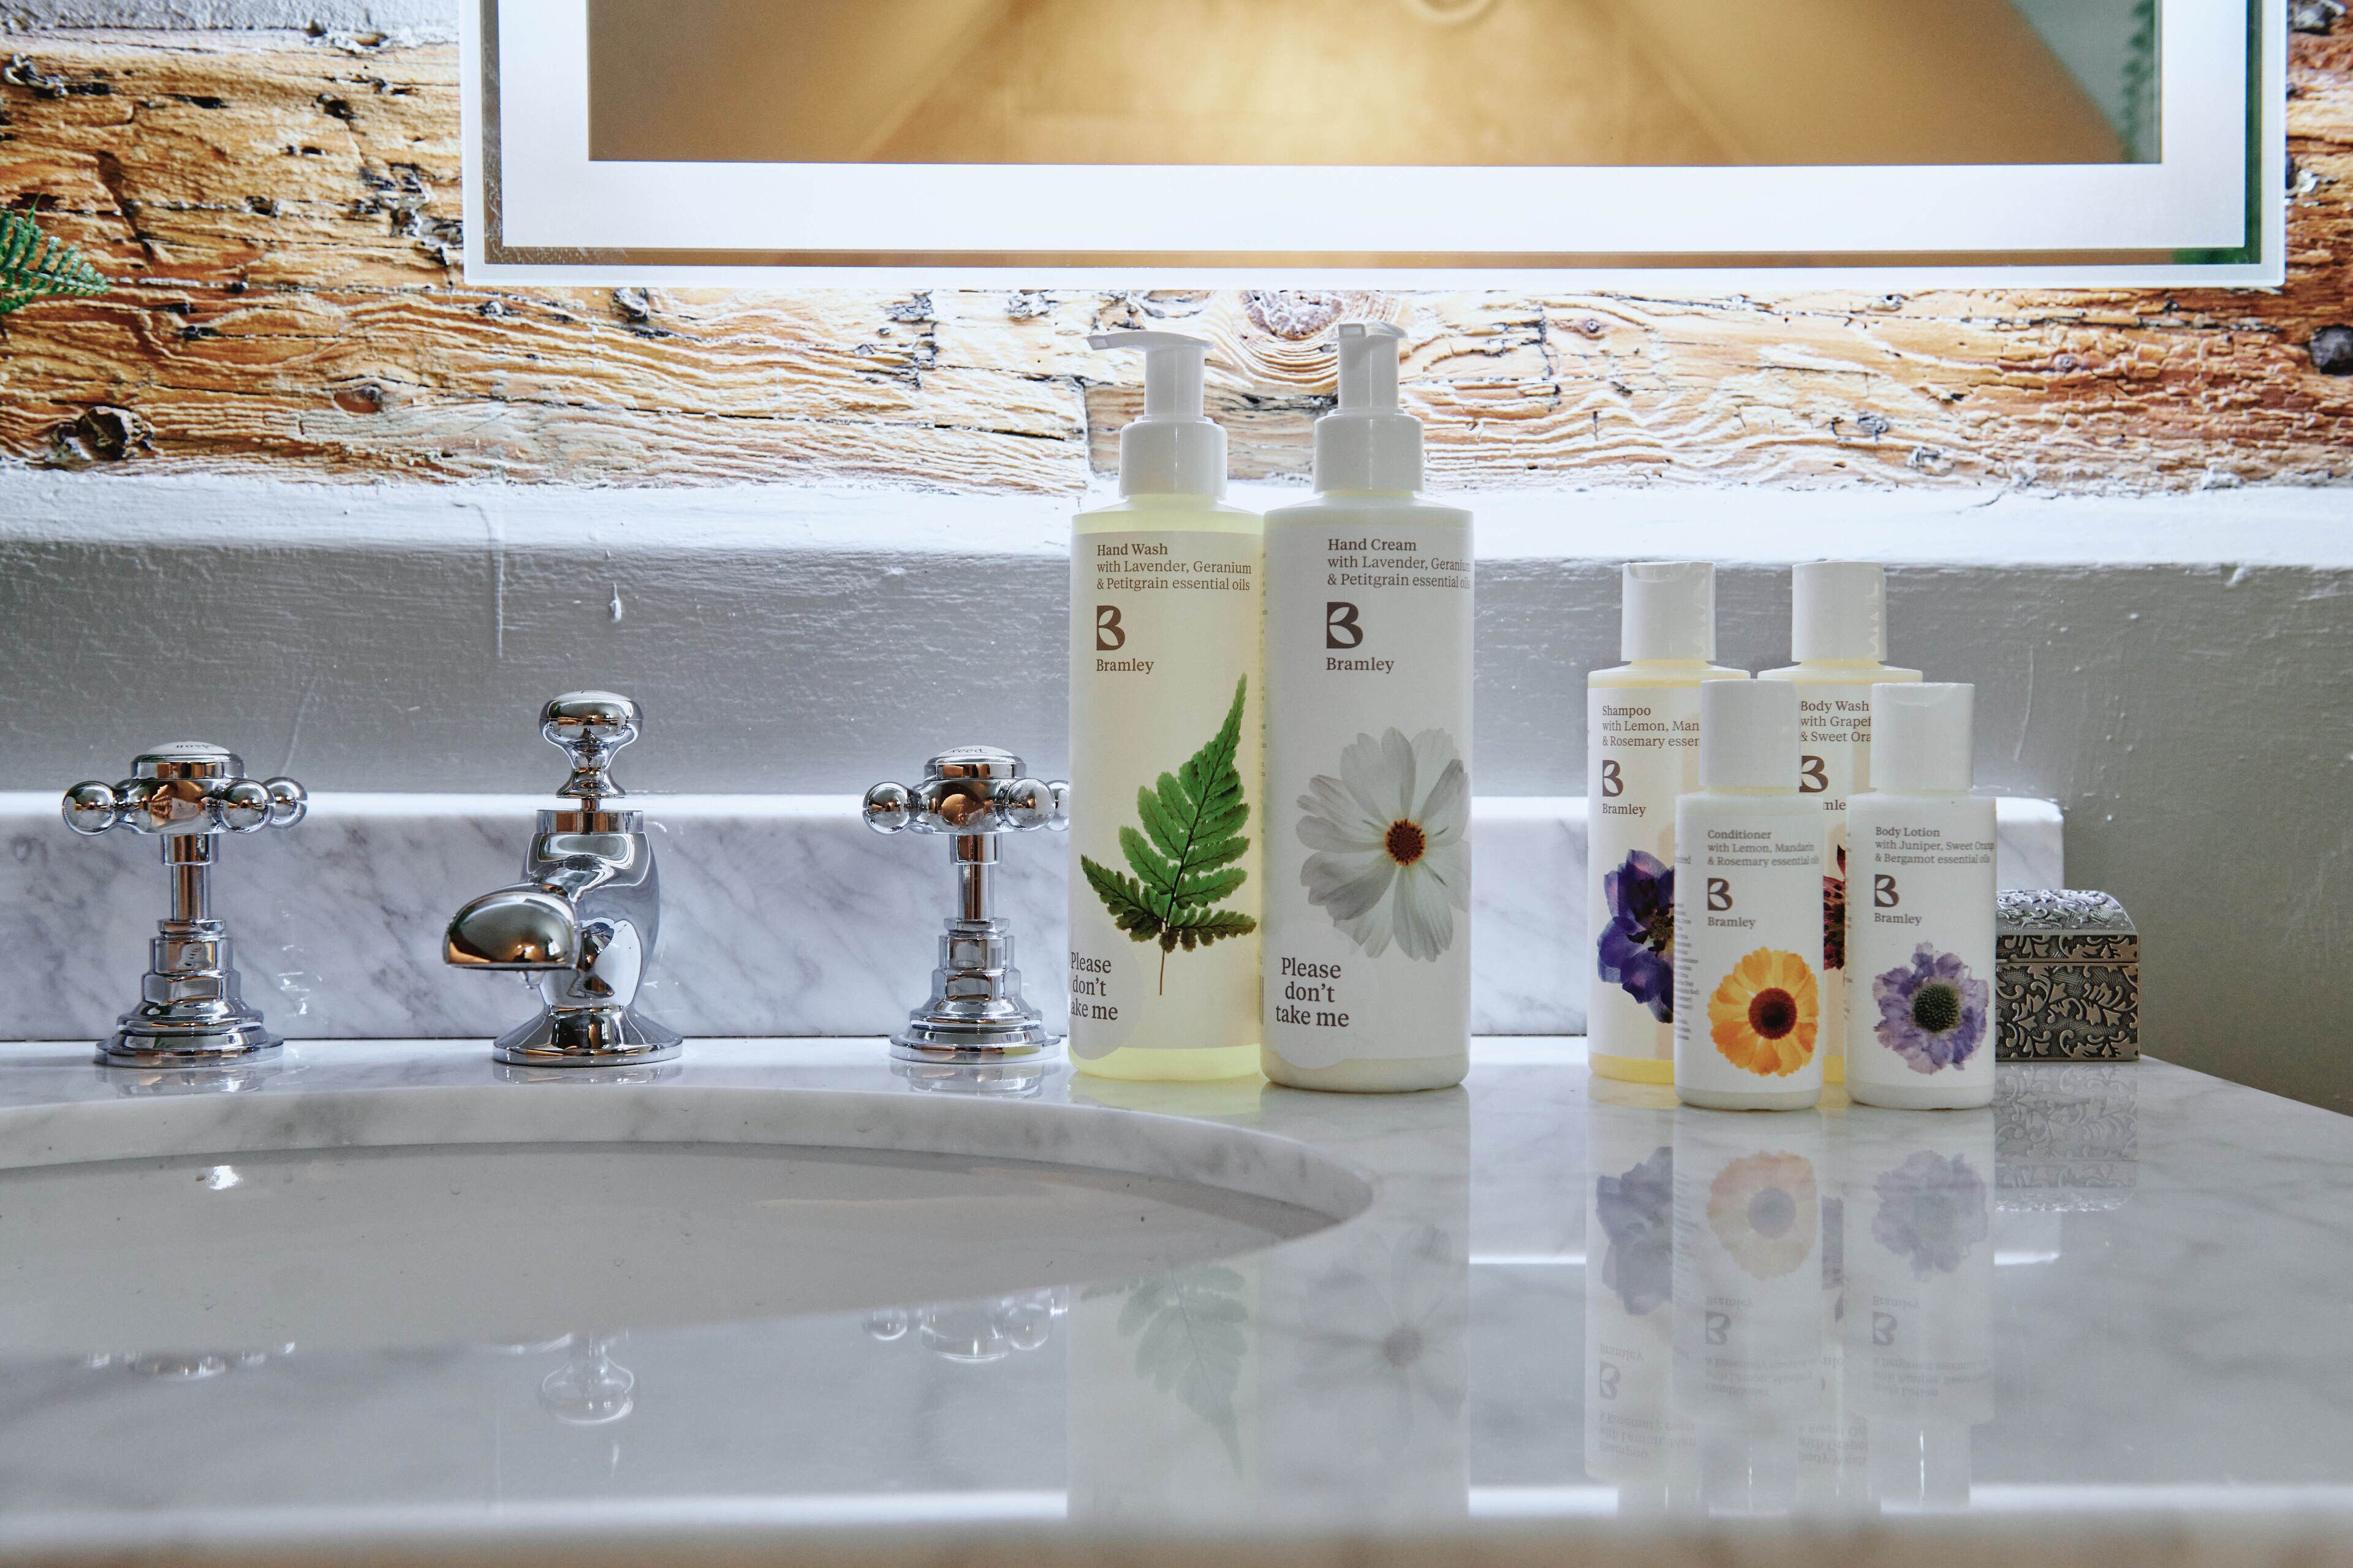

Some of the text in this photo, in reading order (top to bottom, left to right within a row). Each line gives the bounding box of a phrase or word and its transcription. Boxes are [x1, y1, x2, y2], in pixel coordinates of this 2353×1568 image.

[1097, 543, 1168, 556] Hand Wash
[1328, 539, 1417, 551] Hand Cream
[1097, 560, 1251, 574] with Lavender, Geranium
[1328, 556, 1358, 568] with
[1363, 556, 1428, 570] Lavender,
[1097, 577, 1250, 591] & Petitgrain essential oils
[1328, 575, 1337, 585] &
[1342, 574, 1409, 588] Petitgrain
[1413, 576, 1458, 588] essential
[1097, 605, 1126, 651] B
[1327, 602, 1363, 649] B
[1096, 658, 1154, 674] Bramley
[1327, 657, 1395, 673] Bramley
[1602, 705, 1651, 718] Shampoo
[1801, 701, 1870, 713] Body Wash
[1602, 721, 1621, 731] with
[1624, 721, 1669, 732] Lemon,
[1800, 716, 1826, 727] with
[1602, 736, 1608, 746] &
[1610, 736, 1665, 749] Rosemary
[1800, 732, 1808, 741] &
[1811, 732, 1847, 741] Sweet
[1602, 760, 1623, 797] B
[1602, 803, 1646, 817] Bramley
[1708, 830, 1771, 839] Conditioner
[1875, 827, 1940, 838] Body Lotion
[1708, 843, 1729, 852] with
[1732, 843, 1772, 854] Lemon,
[1875, 839, 1896, 850] with
[1899, 840, 1943, 852] Juniper,
[1946, 841, 1972, 850] Sweet
[1708, 857, 1715, 865] &
[1717, 857, 1770, 868] Rosemary
[1771, 855, 1809, 865] essential
[1875, 854, 1882, 862] &
[1884, 854, 1934, 865] Bergamot
[1938, 854, 1978, 863] essential
[1708, 877, 1733, 911] B
[1874, 874, 1900, 907] B
[1708, 917, 1756, 929] Bramley
[1874, 912, 1922, 926] Bramley
[1070, 952, 1112, 973] Please
[1281, 957, 1341, 979] Please
[1072, 975, 1107, 996] don't
[1285, 981, 1335, 1002] don't
[1070, 999, 1118, 1021] ake me
[1276, 1004, 1349, 1027] take me
